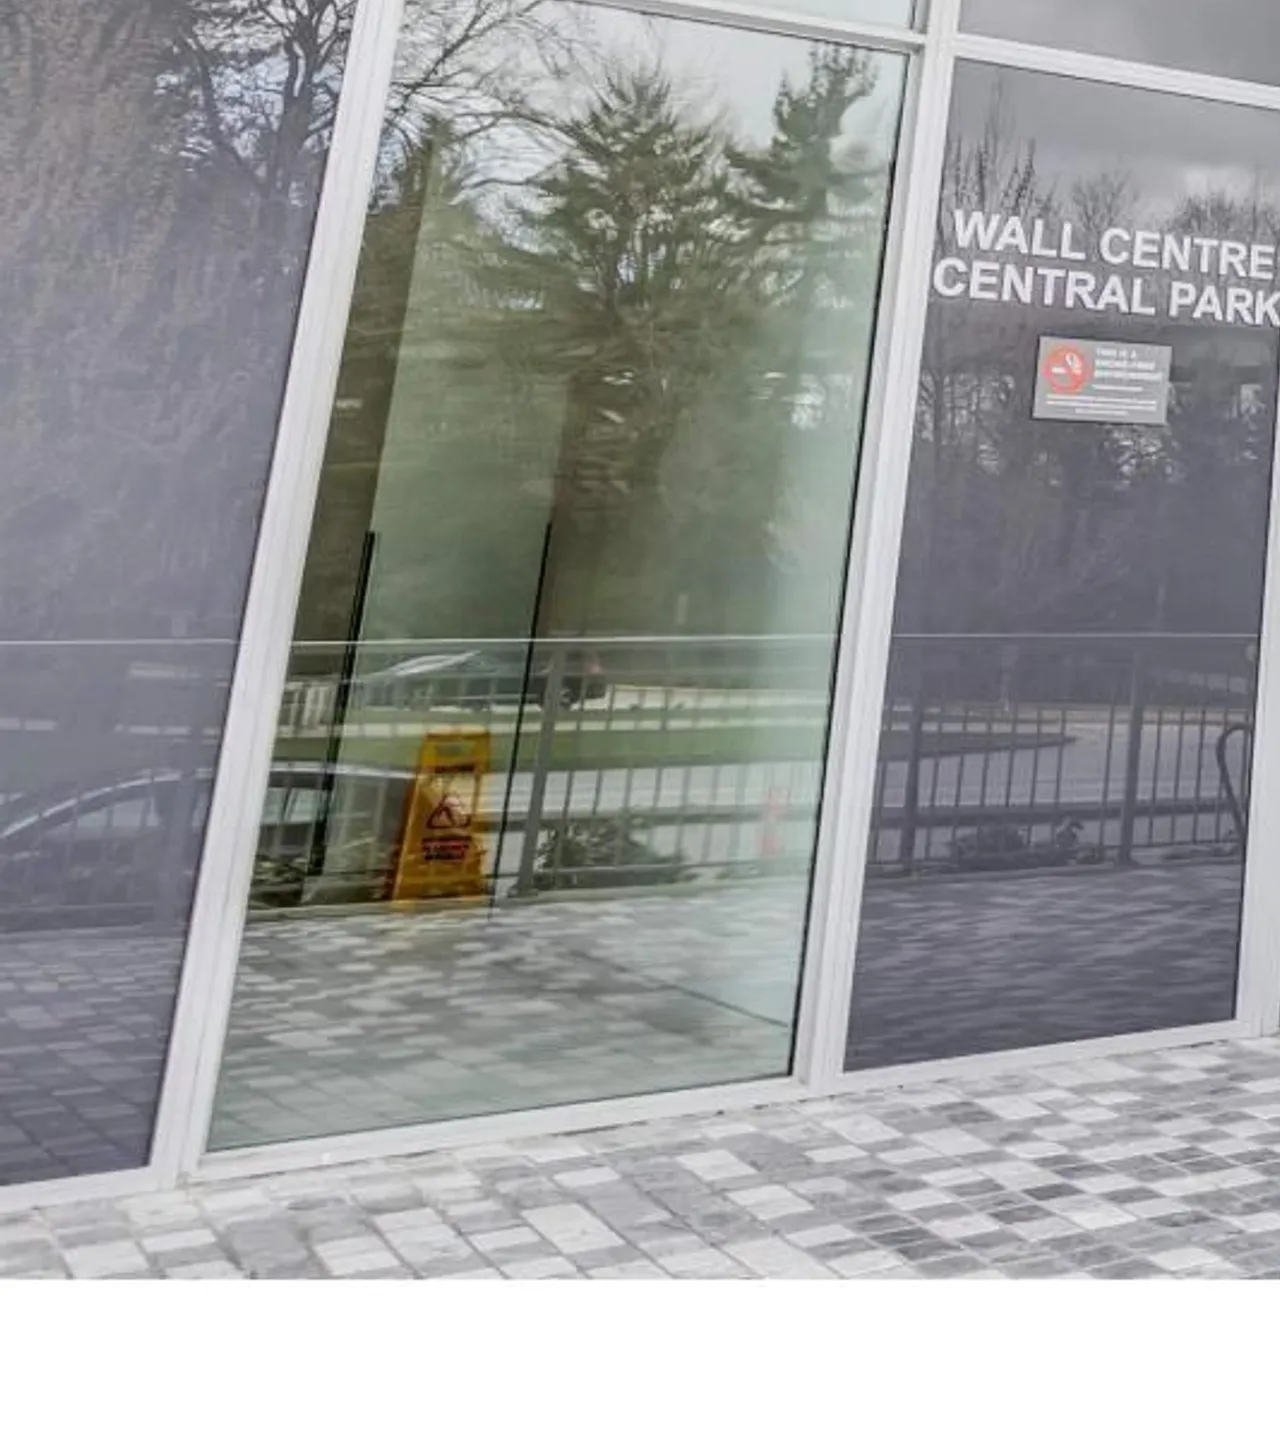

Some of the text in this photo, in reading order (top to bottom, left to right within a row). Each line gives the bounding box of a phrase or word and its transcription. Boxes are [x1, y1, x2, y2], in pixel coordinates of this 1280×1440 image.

[953, 208, 1276, 280] WALL CENTRE
[932, 257, 1156, 315] CENTRAL
